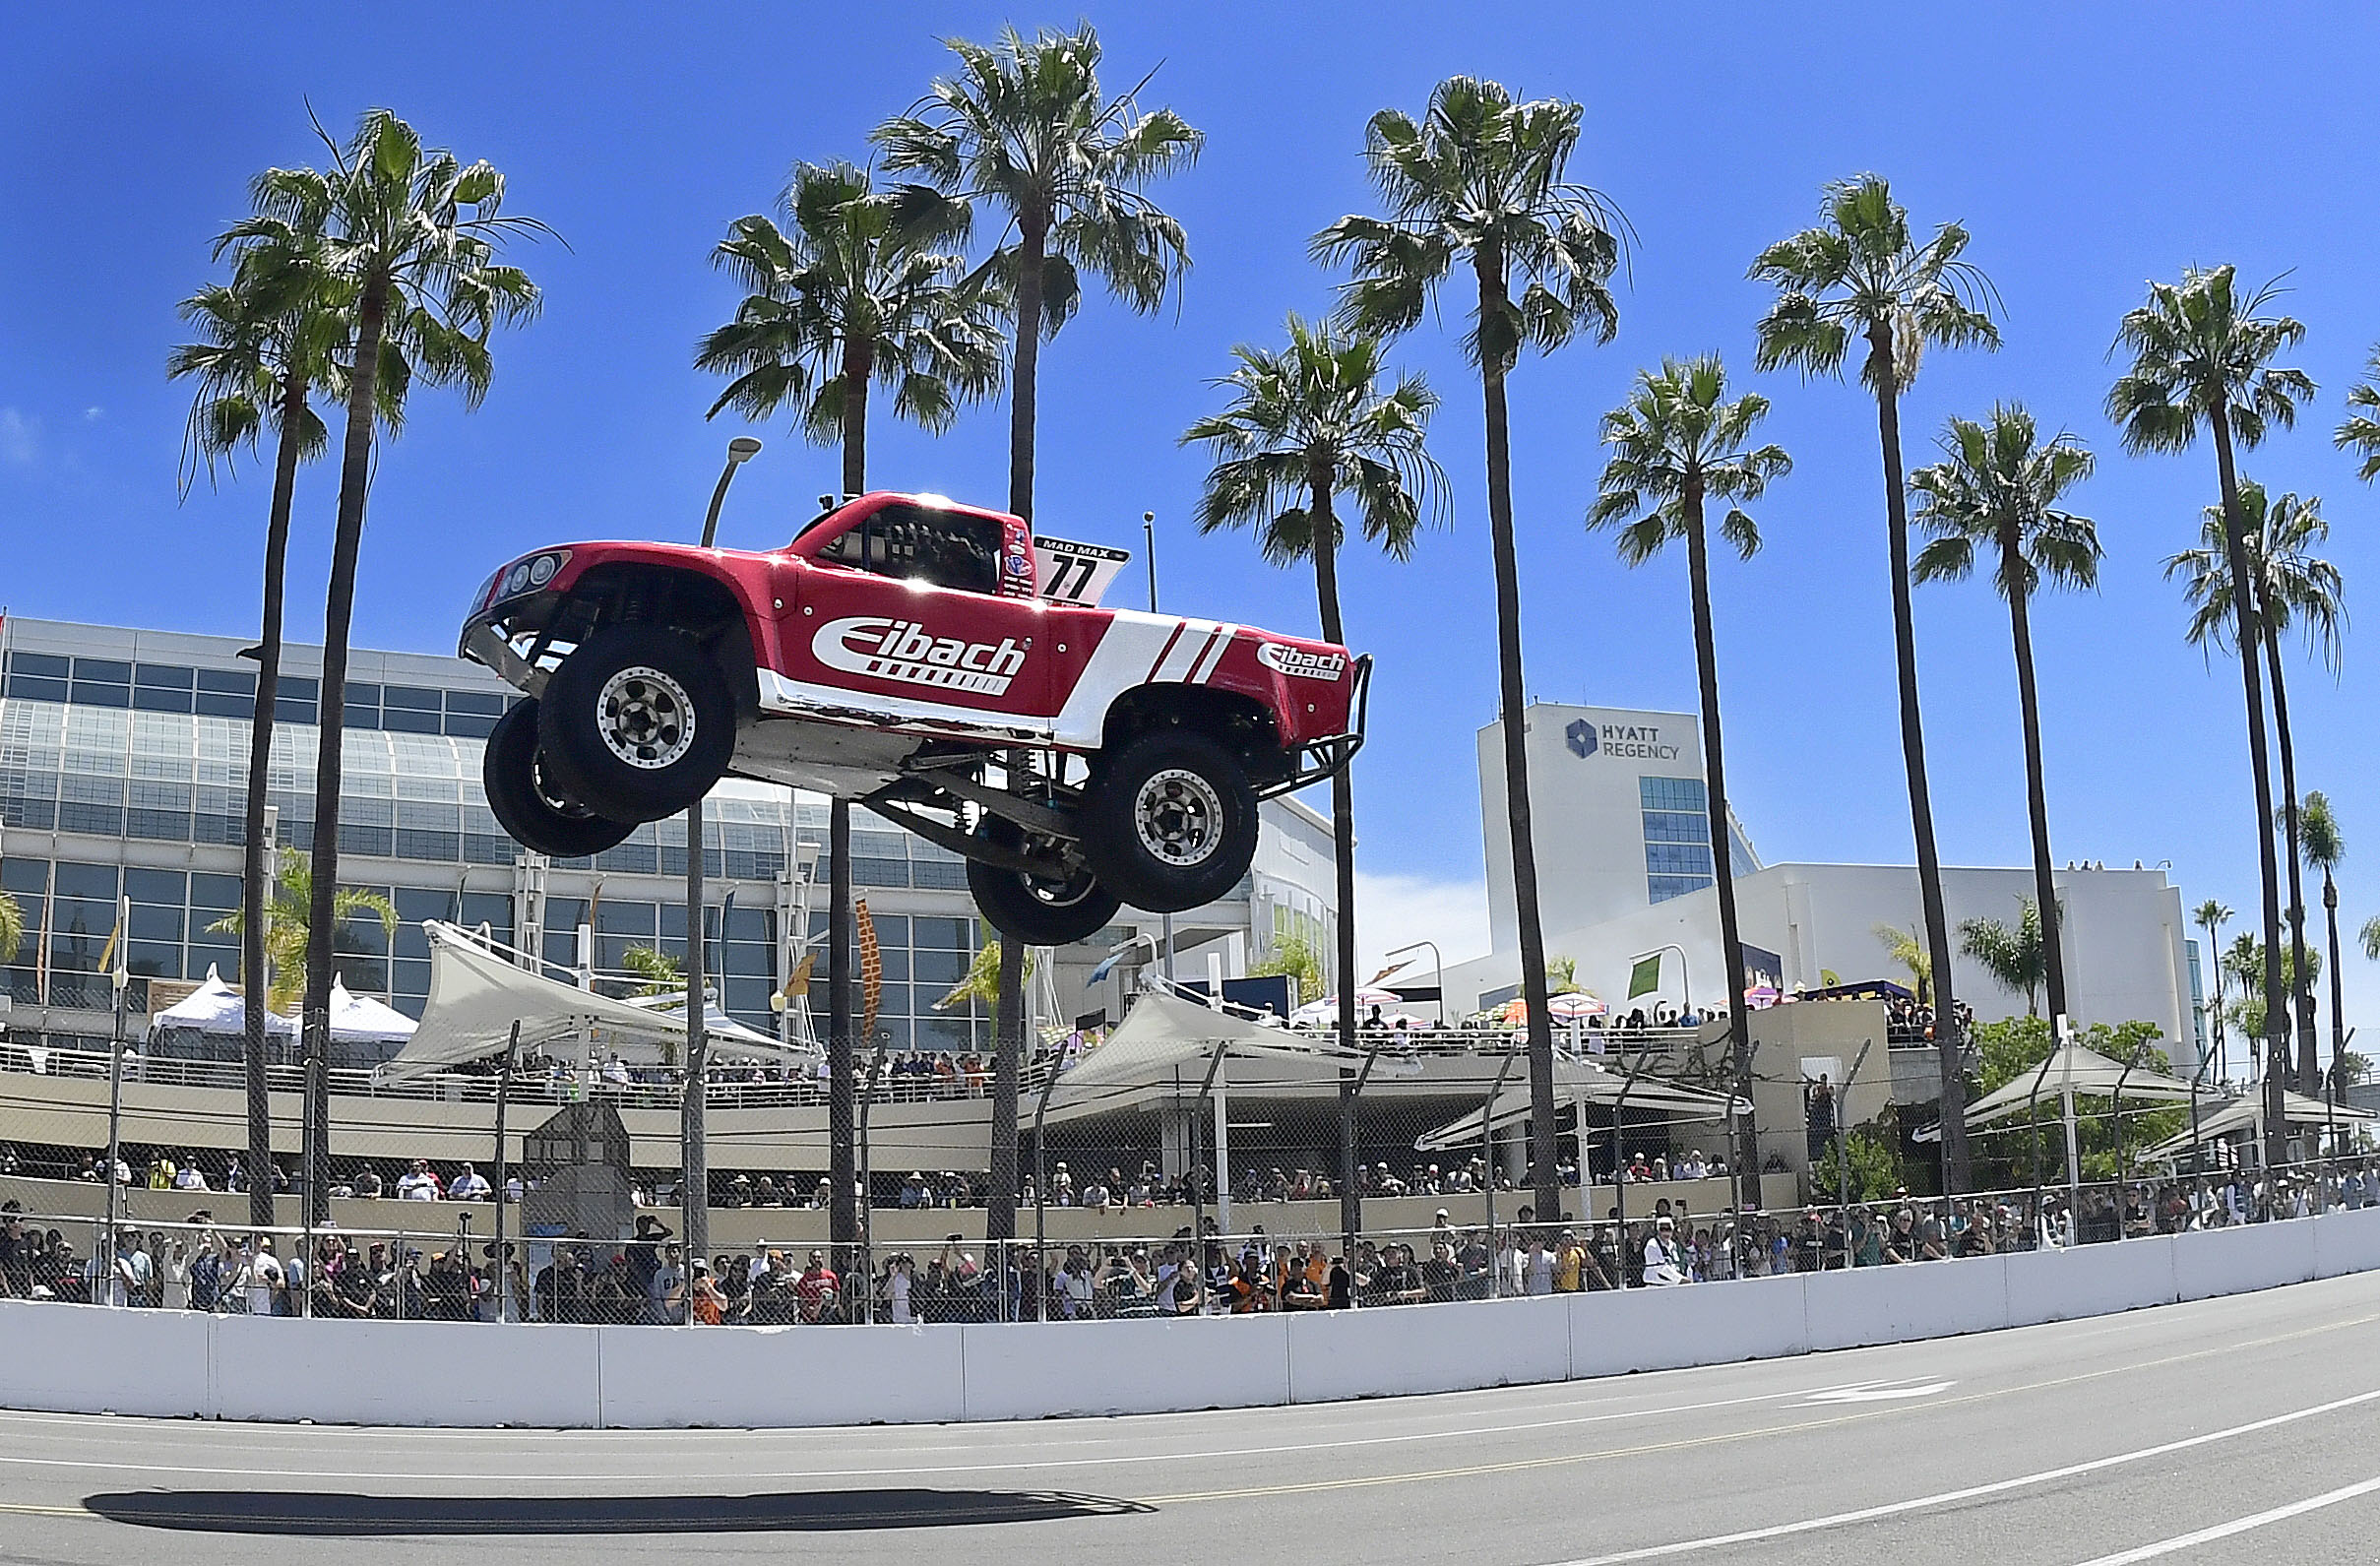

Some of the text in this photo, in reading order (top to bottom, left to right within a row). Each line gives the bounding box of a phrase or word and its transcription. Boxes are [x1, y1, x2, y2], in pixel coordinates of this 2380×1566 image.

[1043, 540, 1110, 558] MAD MAX
[1042, 554, 1098, 599] 77
[811, 616, 1027, 696] Eibach
[1257, 642, 1346, 681] Eibach
[1602, 724, 1659, 742] HYATT
[1603, 743, 1679, 760] REGENCY
